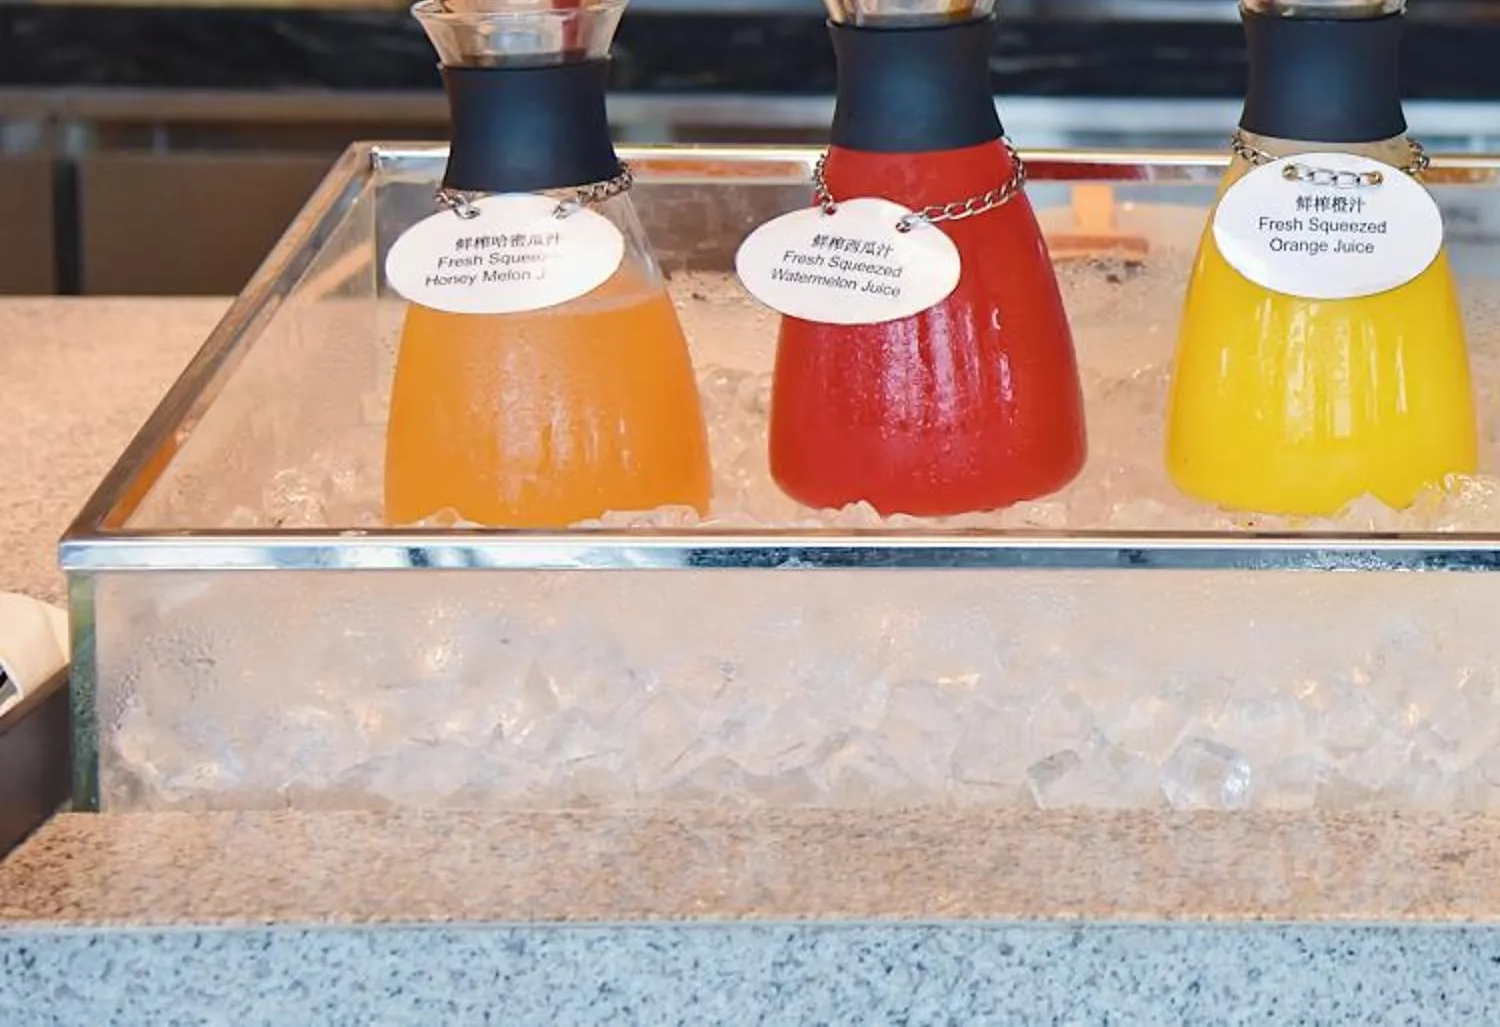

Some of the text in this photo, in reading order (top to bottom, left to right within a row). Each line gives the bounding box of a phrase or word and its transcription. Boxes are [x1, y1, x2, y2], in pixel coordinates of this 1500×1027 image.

[1295, 195, 1366, 214] 鲜榨橙汁
[1258, 216, 1387, 235] Fresh Squeezed
[810, 233, 895, 259] 鲜榨西瓜汁
[1269, 238, 1376, 256] Orange Juice
[437, 255, 484, 269] Fresh
[782, 249, 903, 278] Fresh Squeezed
[425, 274, 476, 287] Honey
[482, 269, 532, 283] Melon
[769, 267, 901, 298] Watermelon Juice
